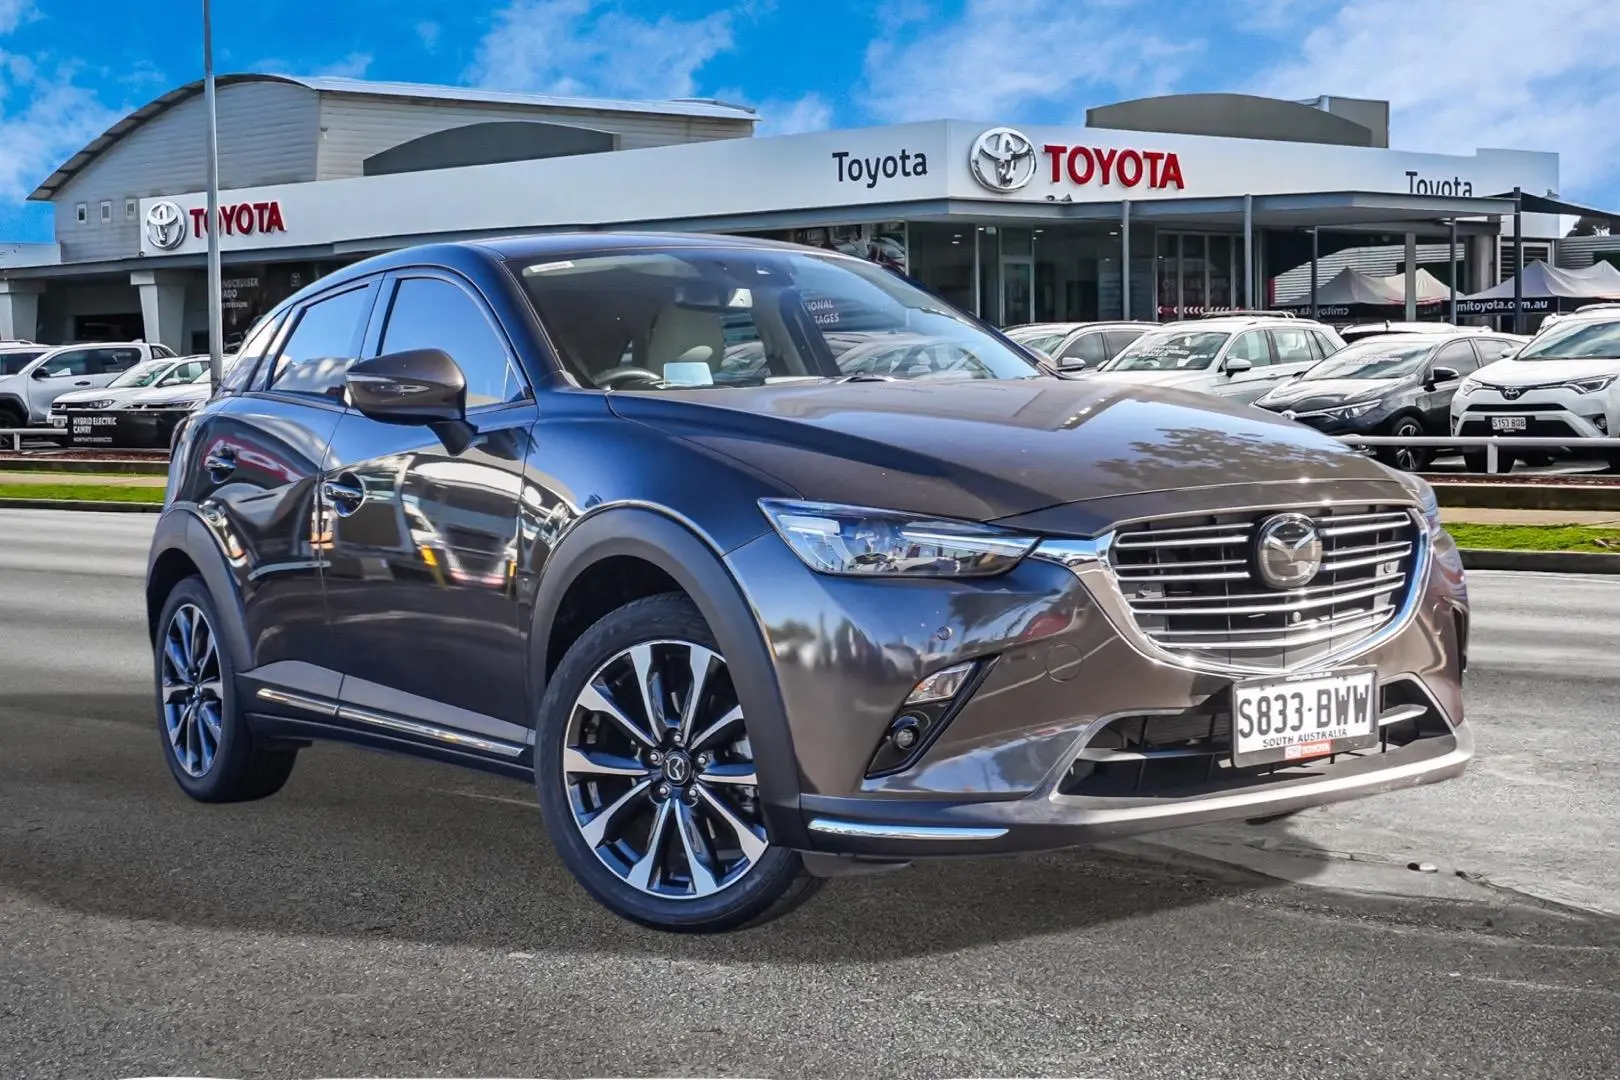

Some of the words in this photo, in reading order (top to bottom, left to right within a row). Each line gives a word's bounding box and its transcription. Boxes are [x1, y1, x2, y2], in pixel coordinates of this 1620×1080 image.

[832, 149, 928, 188] Toyota
[1044, 144, 1185, 189] TOYOTA
[1405, 171, 1473, 197] Toyota
[1262, 736, 1294, 747] SOUTH
[1298, 728, 1347, 742] AUSTRALIA
